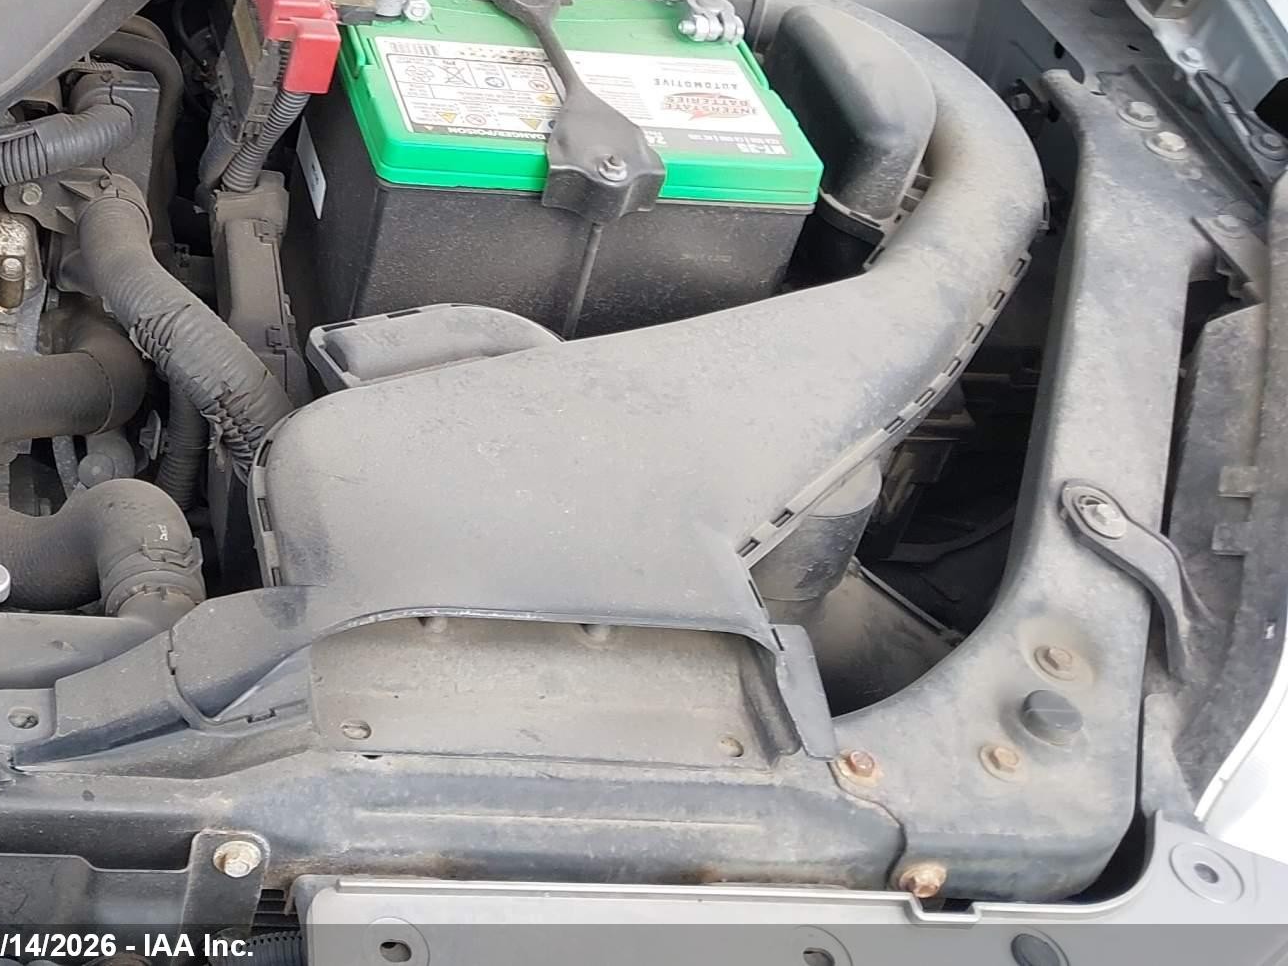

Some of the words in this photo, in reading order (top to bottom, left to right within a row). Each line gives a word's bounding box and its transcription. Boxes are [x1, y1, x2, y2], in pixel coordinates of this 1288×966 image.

[654, 77, 738, 90] AUTOMOTIVE
[664, 95, 749, 107] BATTERIES
[663, 102, 757, 115] INTERSTATE
